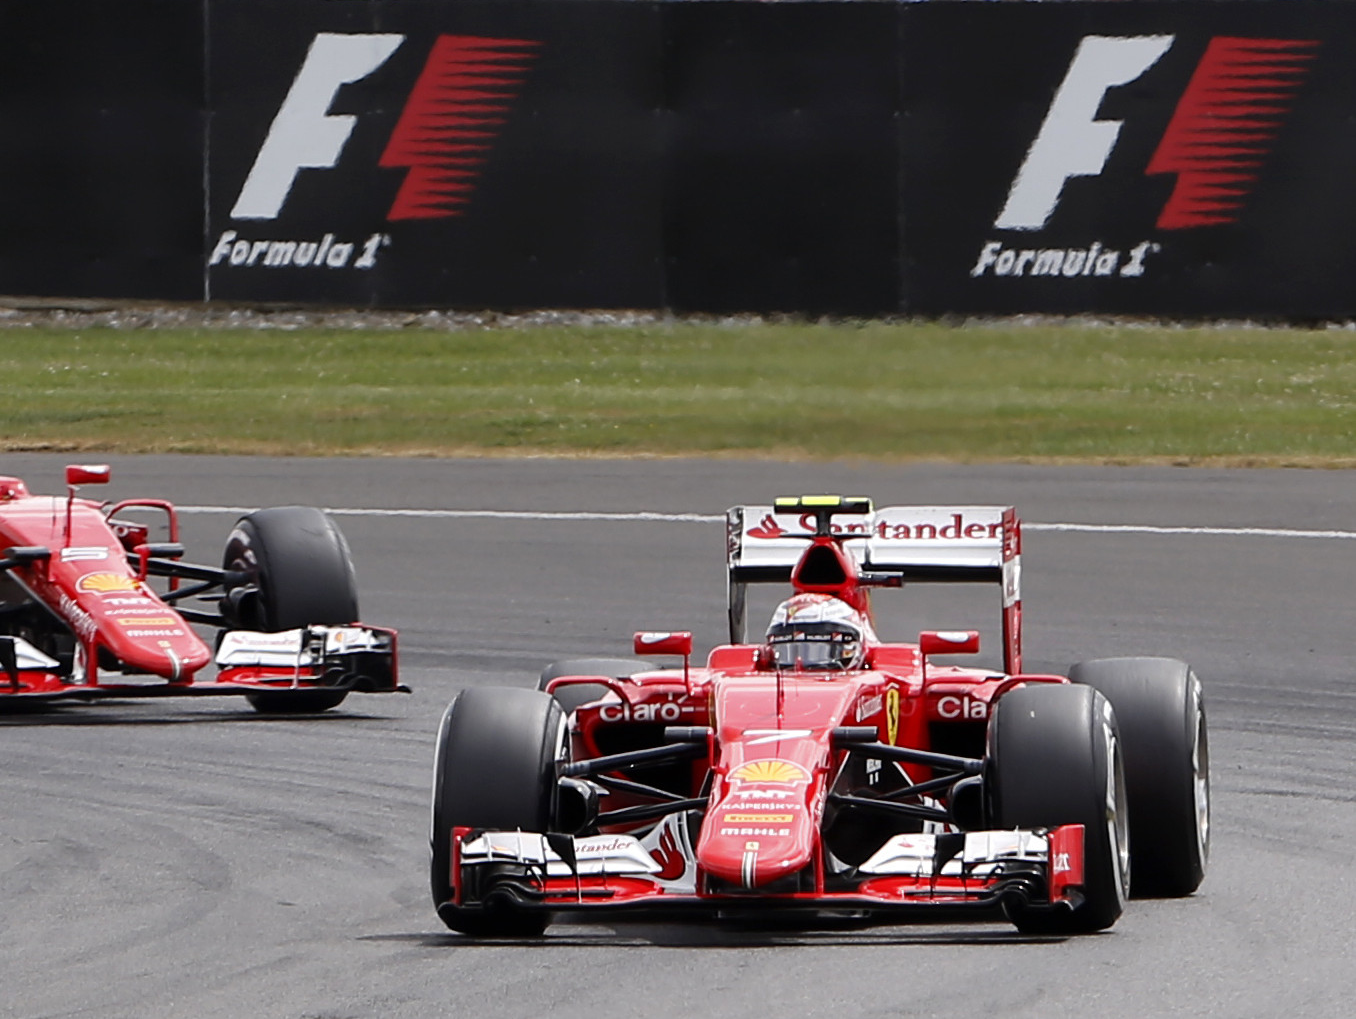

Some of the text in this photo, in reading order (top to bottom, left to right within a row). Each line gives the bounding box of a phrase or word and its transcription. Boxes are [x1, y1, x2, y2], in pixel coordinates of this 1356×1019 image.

[209, 230, 353, 269] Formula
[970, 239, 1119, 277] Formula
[61, 546, 109, 562] 5
[599, 698, 683, 722] Claro
[938, 696, 988, 719] Cla
[721, 828, 790, 836] MAHLE
